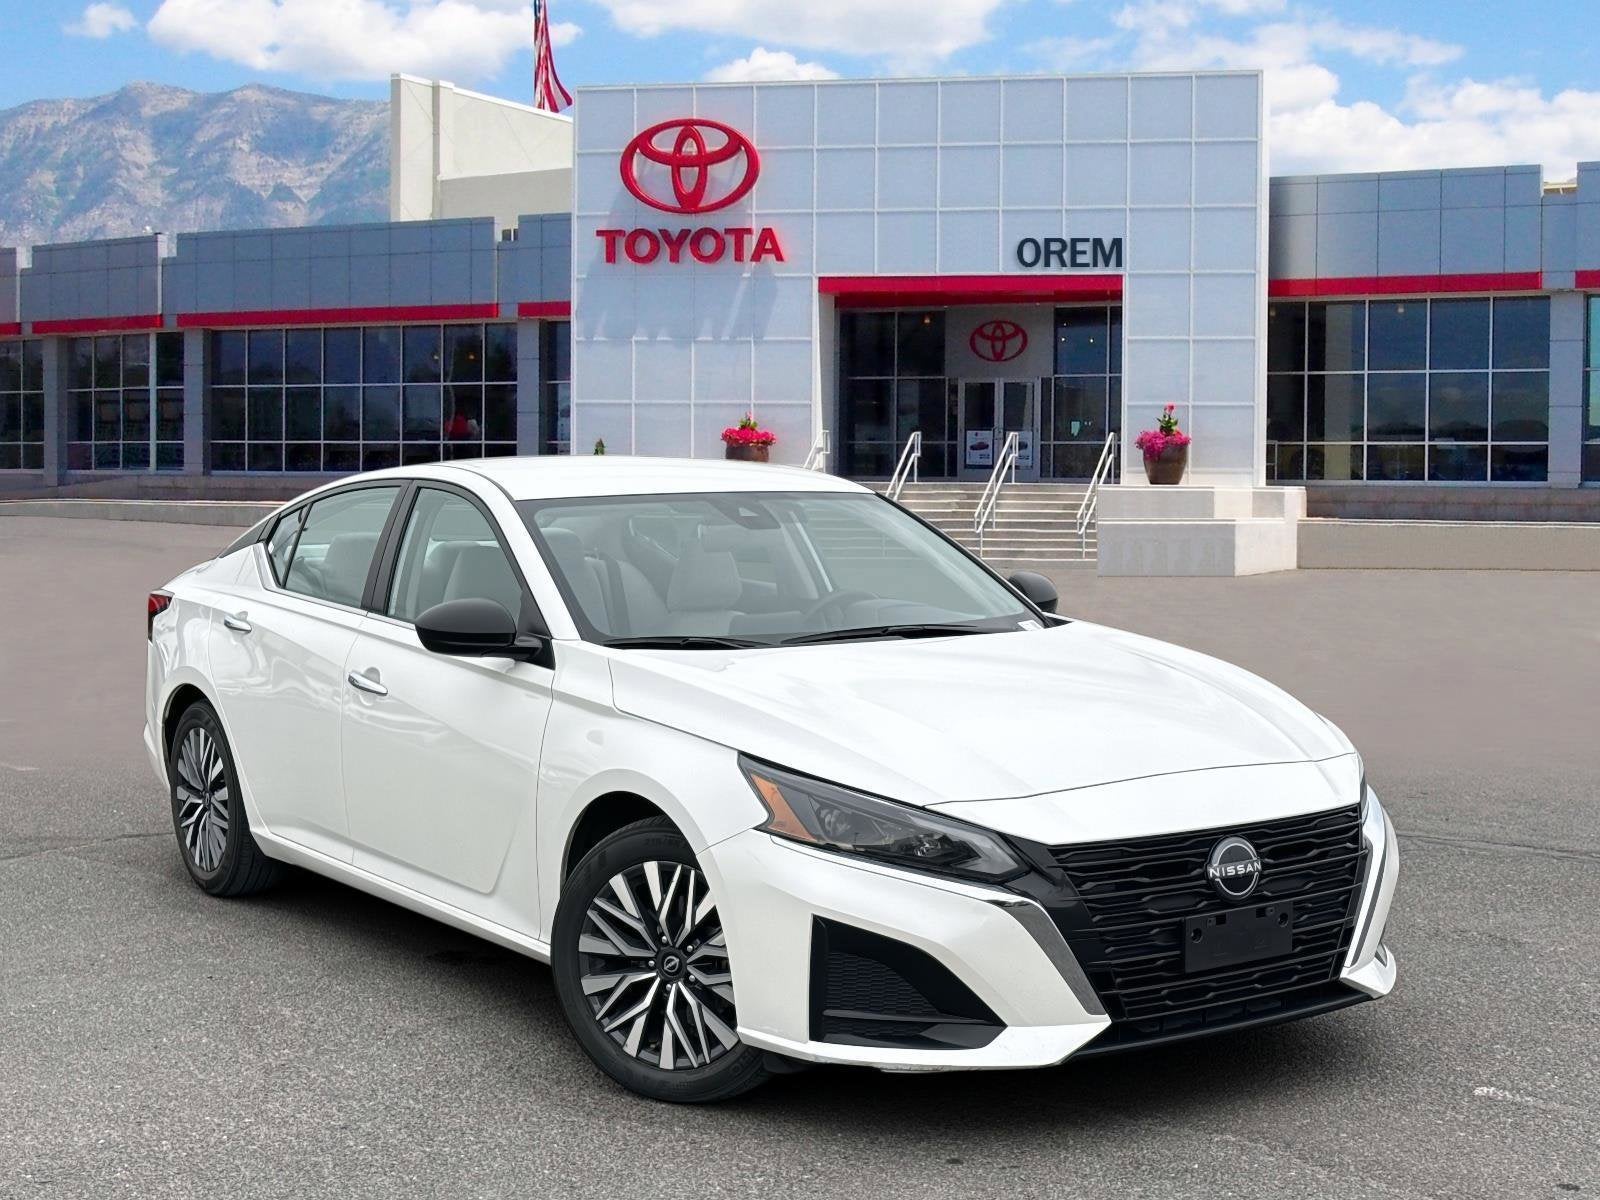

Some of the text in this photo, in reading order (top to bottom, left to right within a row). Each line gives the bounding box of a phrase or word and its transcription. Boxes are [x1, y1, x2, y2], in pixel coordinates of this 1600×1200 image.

[596, 227, 784, 264] TOYOTA
[1017, 237, 1122, 268] OREM
[1209, 861, 1261, 878] NISSAN
